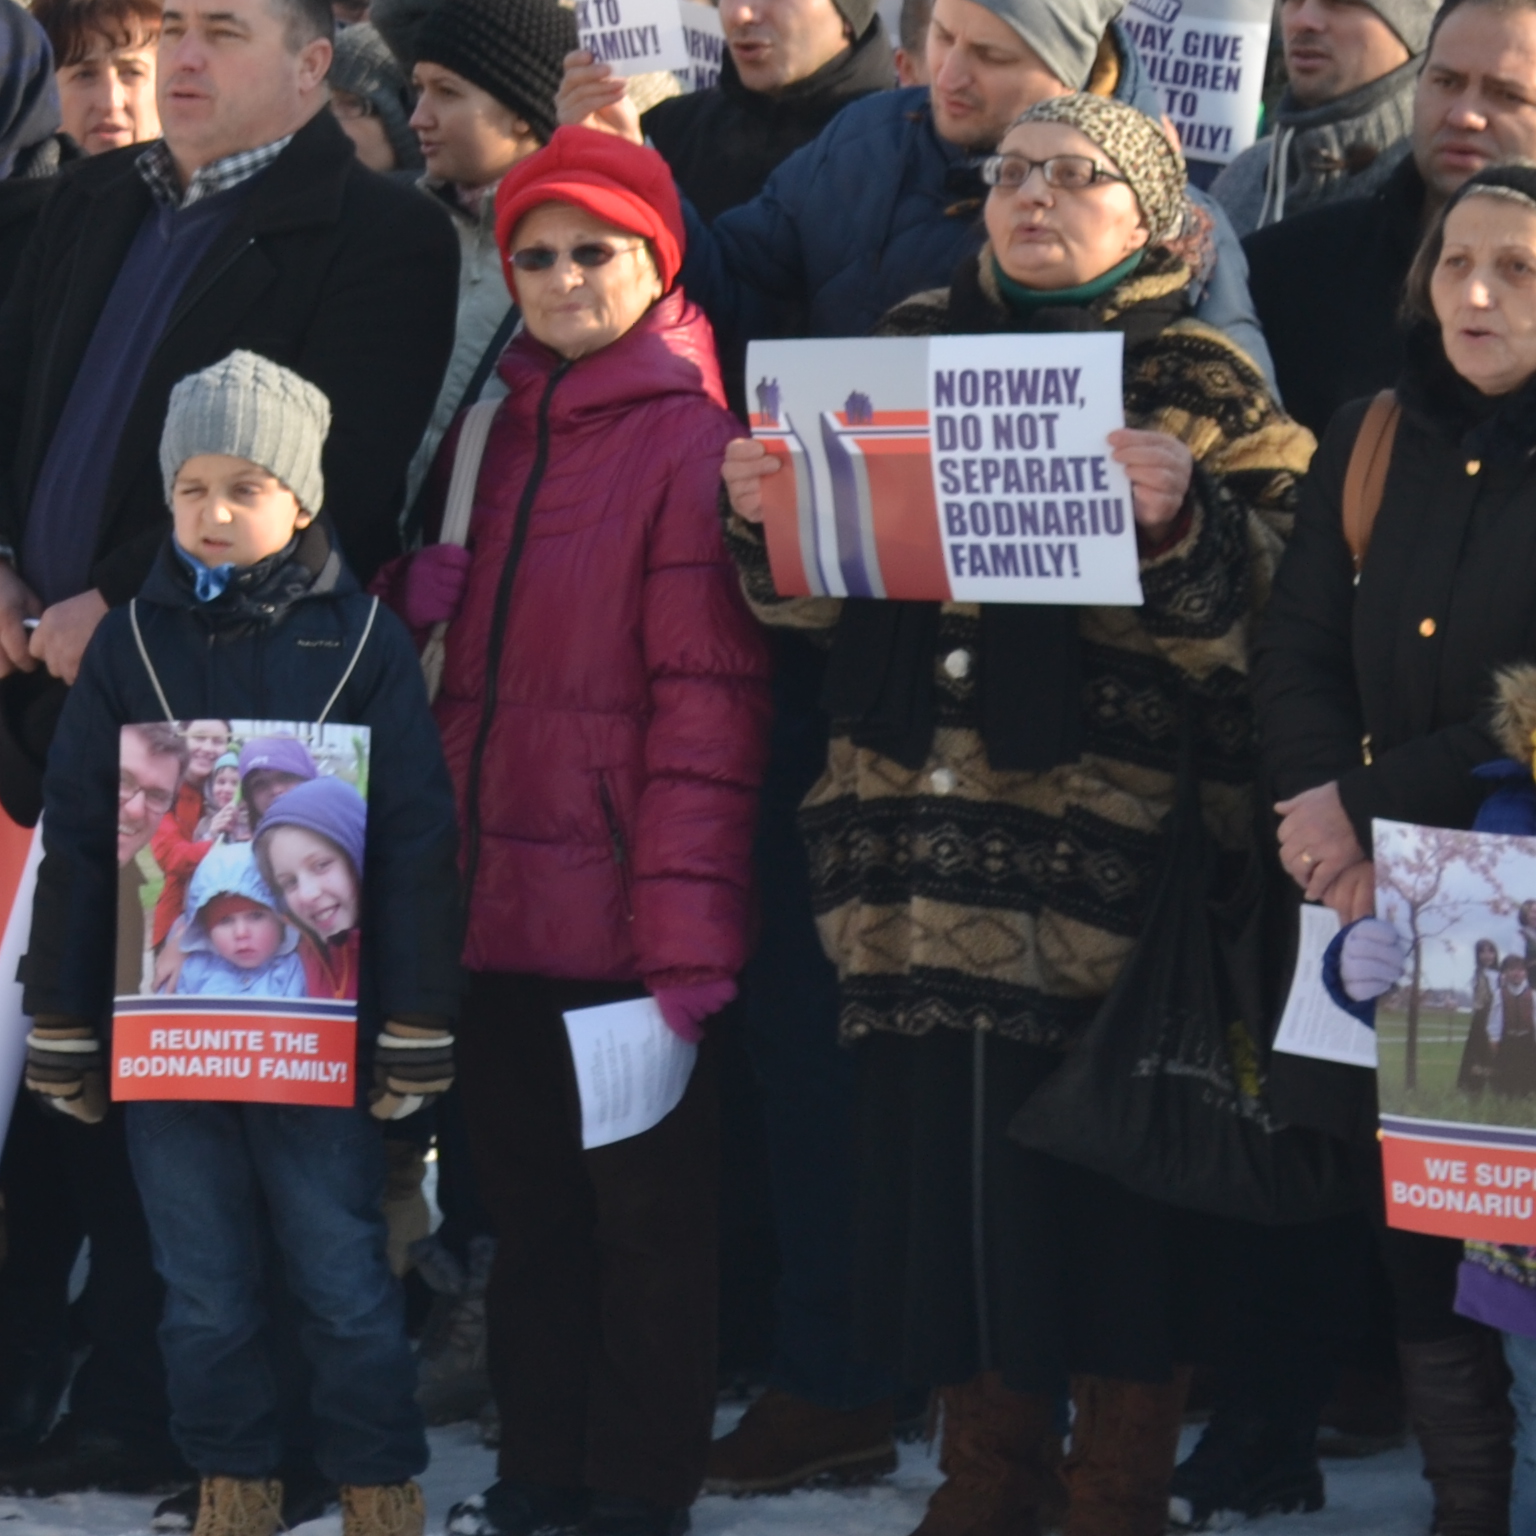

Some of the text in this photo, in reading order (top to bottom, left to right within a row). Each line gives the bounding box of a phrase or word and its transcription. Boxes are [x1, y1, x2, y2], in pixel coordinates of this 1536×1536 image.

[1183, 30, 1243, 61] GIVE
[1165, 89, 1198, 118] TO
[934, 368, 1086, 410] NORWAY,
[936, 413, 1059, 452] DO NOT
[939, 456, 1109, 495] SEPARATE
[944, 498, 1125, 537] BODNARIU
[950, 543, 1081, 578] FAMILY!
[150, 1029, 319, 1054] REUNITE THE
[118, 1056, 348, 1084] BODNARIU FAMILY!
[1424, 1158, 1468, 1184] WE
[1392, 1180, 1534, 1220] BODNARIU
